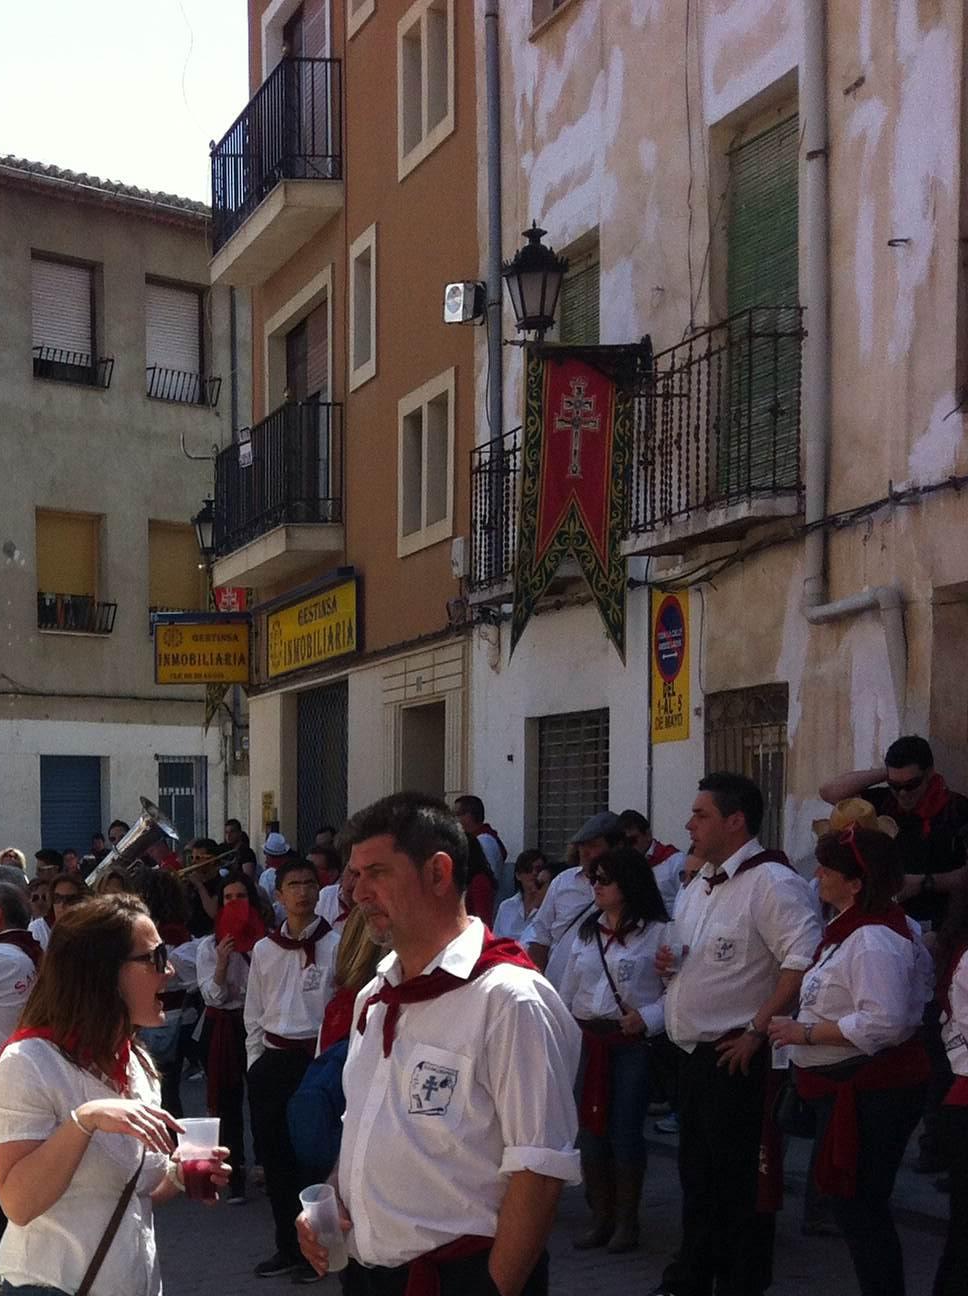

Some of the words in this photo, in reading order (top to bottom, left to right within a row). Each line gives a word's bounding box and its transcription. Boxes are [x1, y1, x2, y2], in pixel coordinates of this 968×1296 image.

[298, 595, 338, 626] GESTINSA
[192, 632, 239, 642] GESTINSA
[283, 618, 355, 666] INMOBILIARIA
[158, 652, 246, 667] INMOBILIARIA
